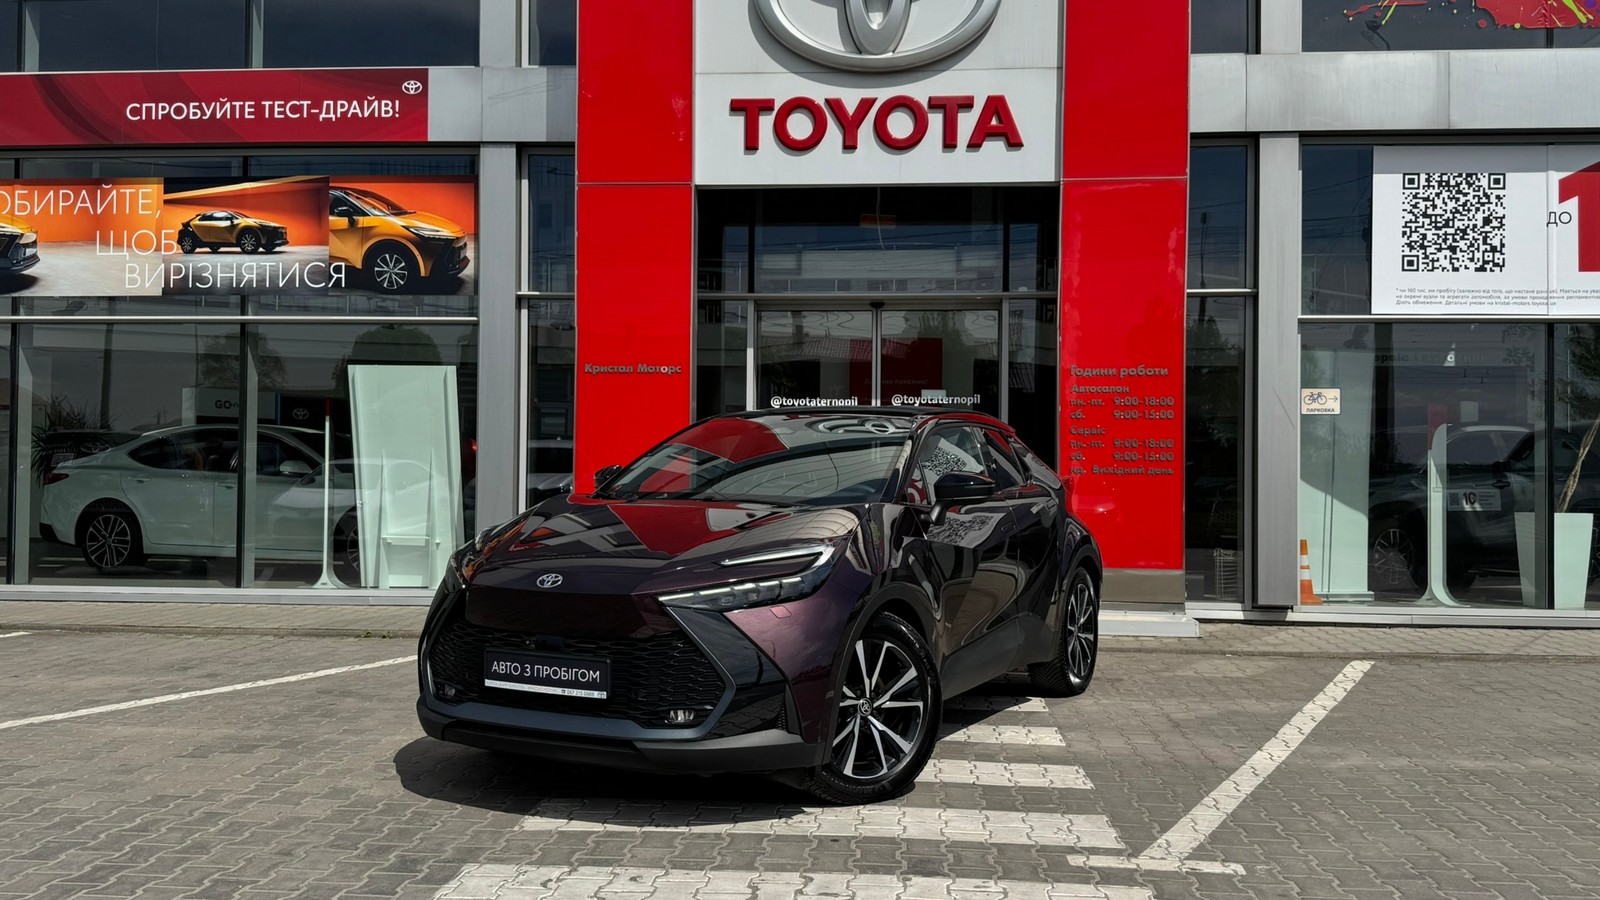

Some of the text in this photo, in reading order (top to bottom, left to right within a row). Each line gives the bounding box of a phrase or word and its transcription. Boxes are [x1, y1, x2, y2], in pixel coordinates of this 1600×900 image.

[126, 95, 400, 121] СПРОБУЙТЕ ТЕСТ-ДРАЙВ!
[730, 94, 1025, 152] TOYOTA
[96, 228, 177, 260] ЩОБ
[124, 261, 346, 288] ВИРІЗНЯТИСЯ
[584, 363, 682, 374] Кристал Моторс
[1070, 364, 1169, 378] Години роботи
[1071, 384, 1130, 394] Автосалон
[770, 395, 859, 408] @toyotaternopil
[891, 393, 981, 407] @toyotaternopil
[1070, 409, 1086, 419] сб.
[1070, 424, 1106, 437] Сервіс
[1070, 451, 1086, 461] сб.
[1092, 464, 1145, 476] Вихідний
[1147, 466, 1175, 476] день
[491, 661, 521, 675] АВТО
[534, 665, 600, 683] ПРОБІГОМ
